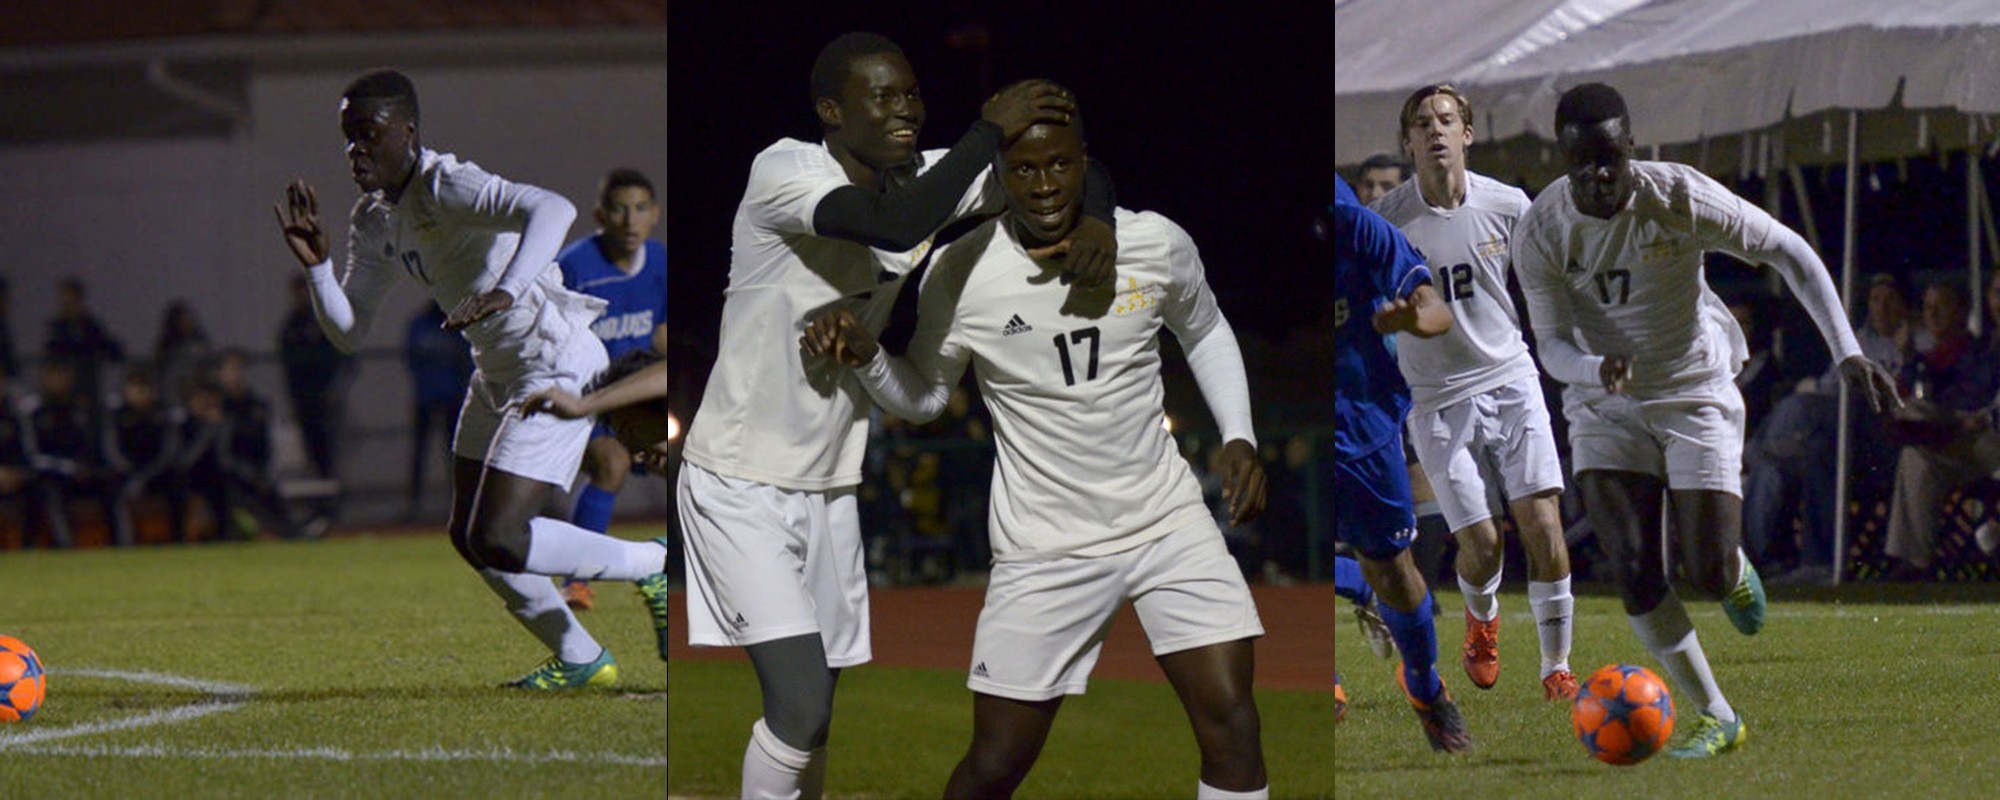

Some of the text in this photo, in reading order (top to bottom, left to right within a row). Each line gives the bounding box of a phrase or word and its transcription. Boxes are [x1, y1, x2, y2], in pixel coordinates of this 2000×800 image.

[1439, 263, 1475, 302] 12
[1594, 268, 1631, 304] 17
[1053, 325, 1100, 387] 17
